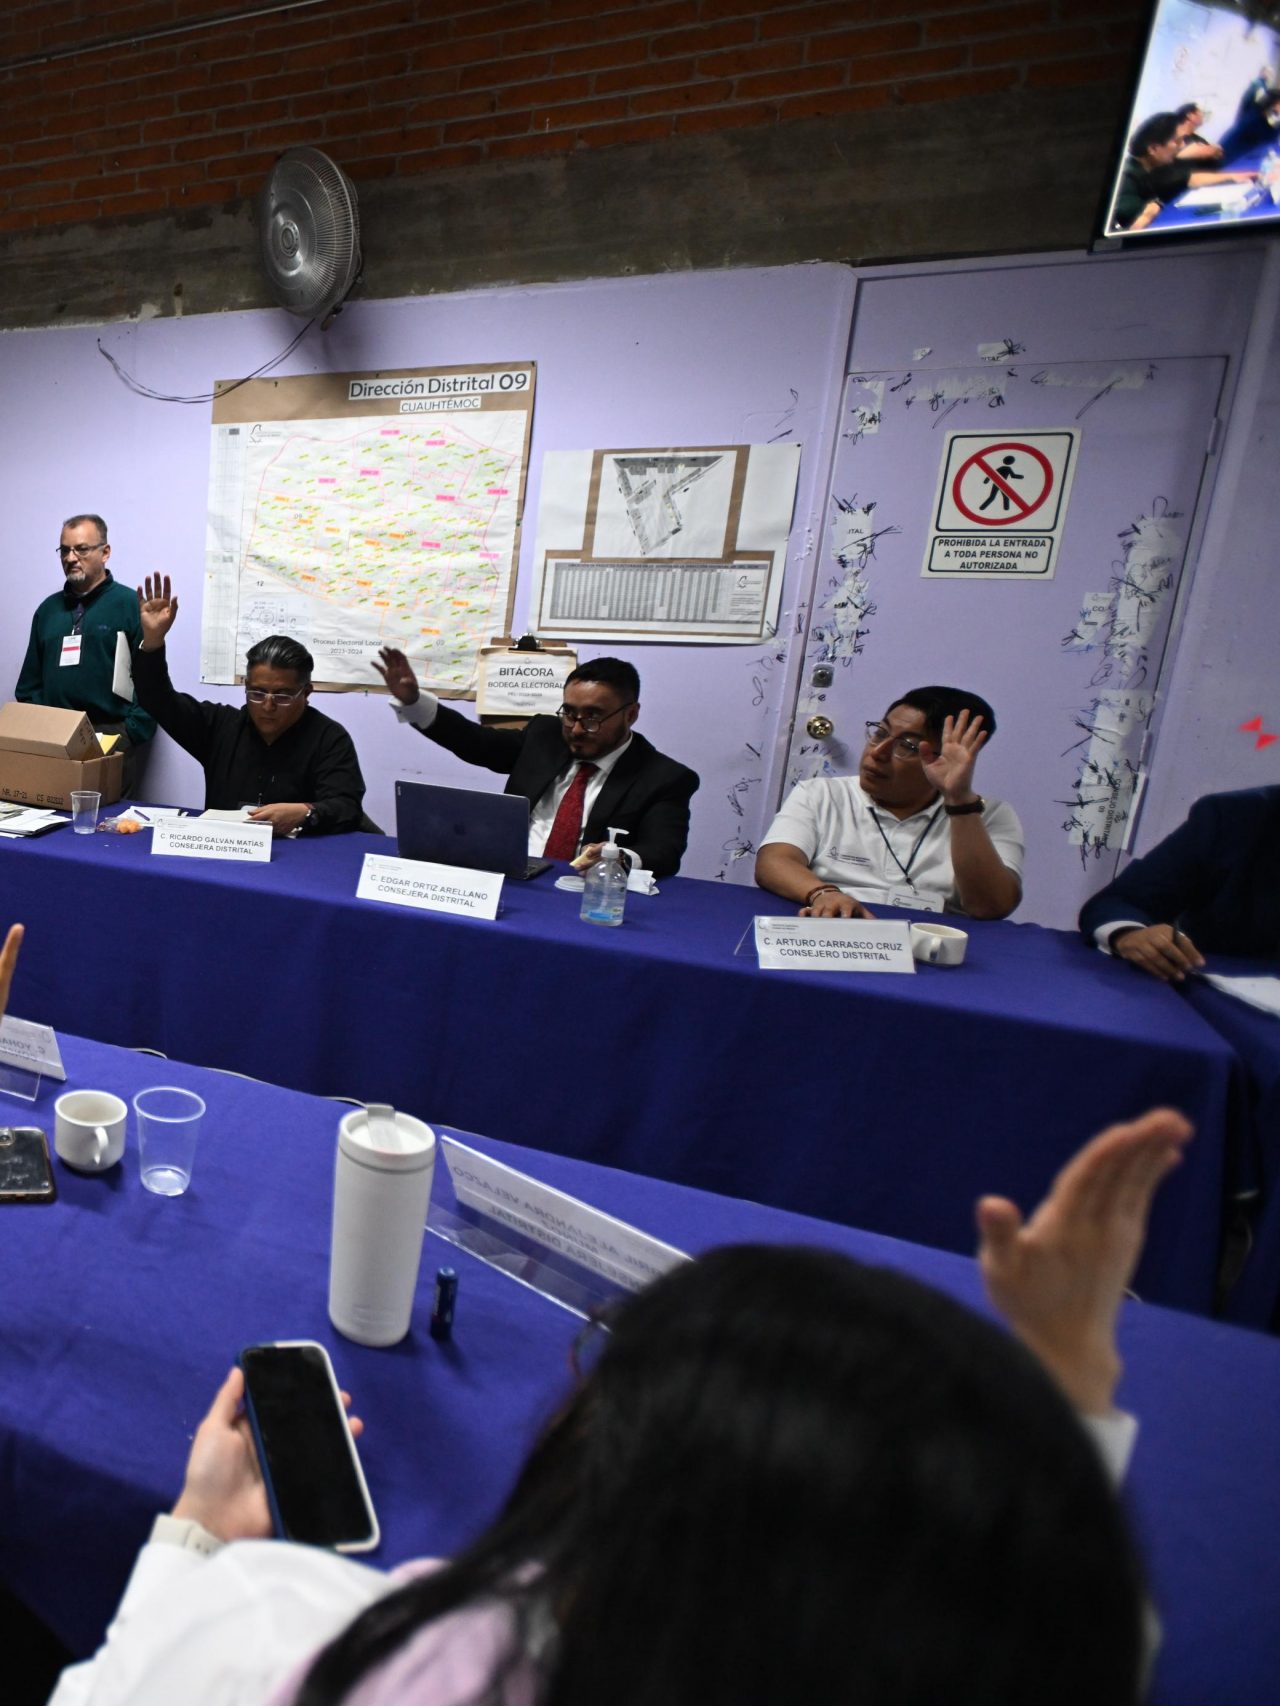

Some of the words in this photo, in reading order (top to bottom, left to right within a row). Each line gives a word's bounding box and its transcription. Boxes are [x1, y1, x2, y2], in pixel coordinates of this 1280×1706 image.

[350, 379, 424, 398] Dirección
[428, 374, 495, 394] Distrital
[499, 373, 527, 390] 09
[401, 398, 479, 412] CUAUHTÉMOC
[938, 539, 987, 547] PROHIBIDA
[989, 539, 1001, 547] LA
[1003, 539, 1047, 547] ENTRADA
[960, 562, 1018, 570] AUTORIZADA
[499, 666, 555, 677] BITÁCORA
[169, 834, 203, 842] RICARDO
[169, 842, 214, 851] CONSEJERA
[216, 846, 253, 854] DISTRITAL
[380, 876, 411, 887] EDGAR
[412, 881, 439, 892] ORTIZ
[439, 886, 488, 900] ARELLANO
[378, 884, 429, 900] CONSEJERA
[431, 894, 476, 908] DISTRITAL
[776, 938, 816, 948] ARTURO
[818, 939, 874, 950] CARRASCO
[876, 942, 903, 951] CRUZ
[779, 948, 840, 959] CONSEJERO
[842, 951, 892, 961] DISTRITAL
